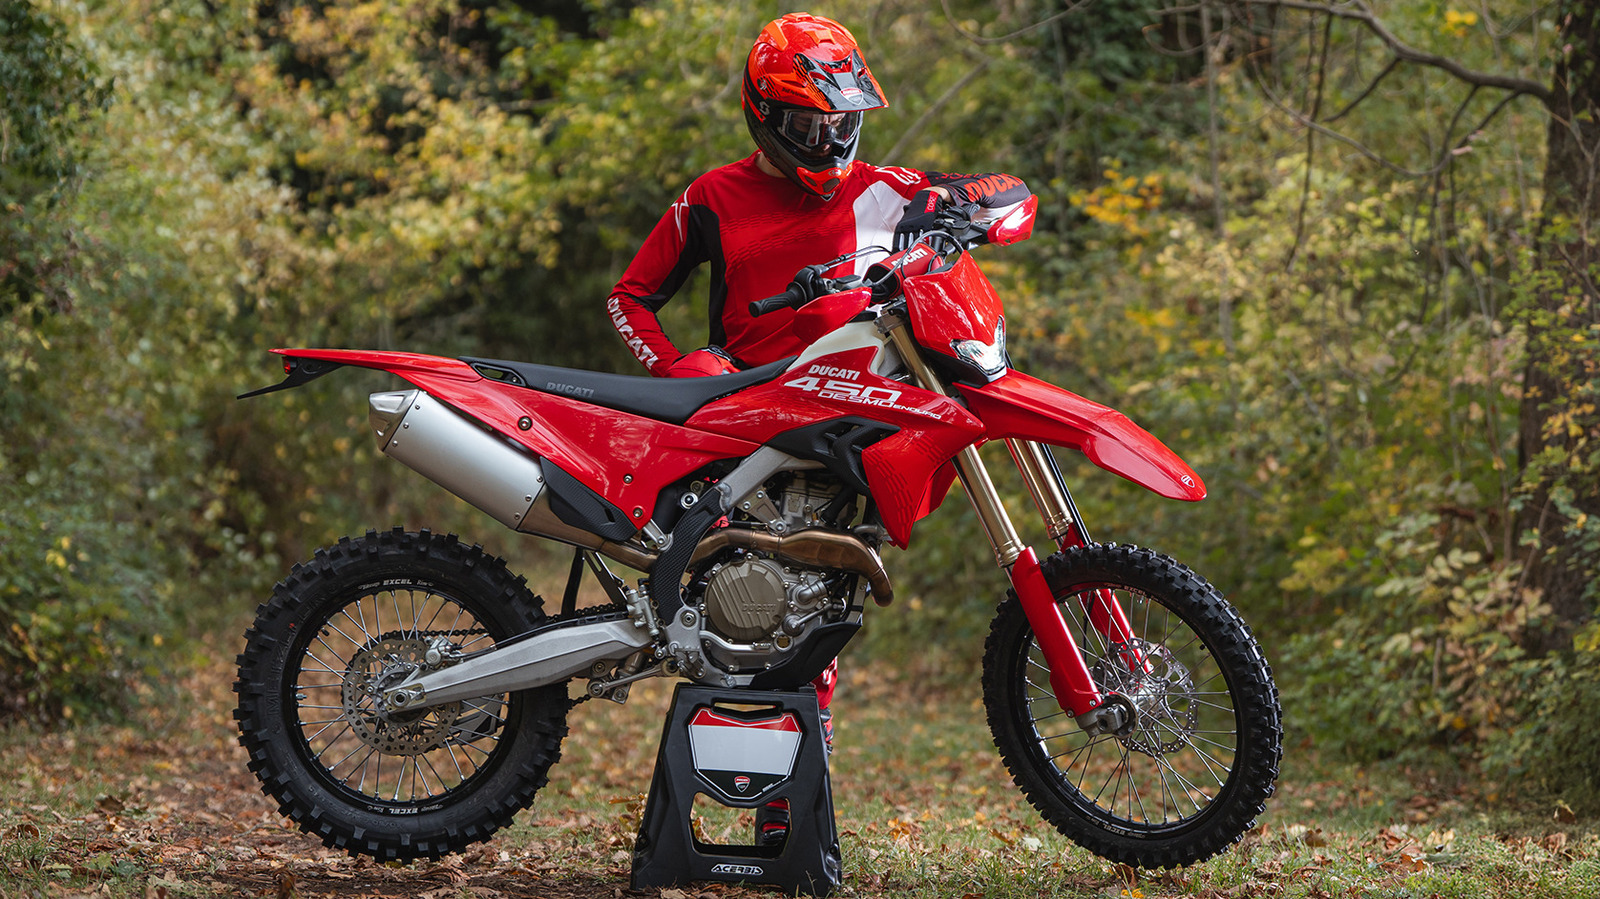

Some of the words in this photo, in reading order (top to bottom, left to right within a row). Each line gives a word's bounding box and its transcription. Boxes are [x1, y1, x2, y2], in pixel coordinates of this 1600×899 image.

[607, 297, 658, 369] DUCATI
[808, 364, 860, 381] DUCATI
[546, 382, 594, 398] DUCATI
[783, 376, 902, 403] 450
[818, 389, 894, 409] DESMO
[893, 404, 942, 420] ENDURO
[711, 864, 763, 875] ACERBIS
